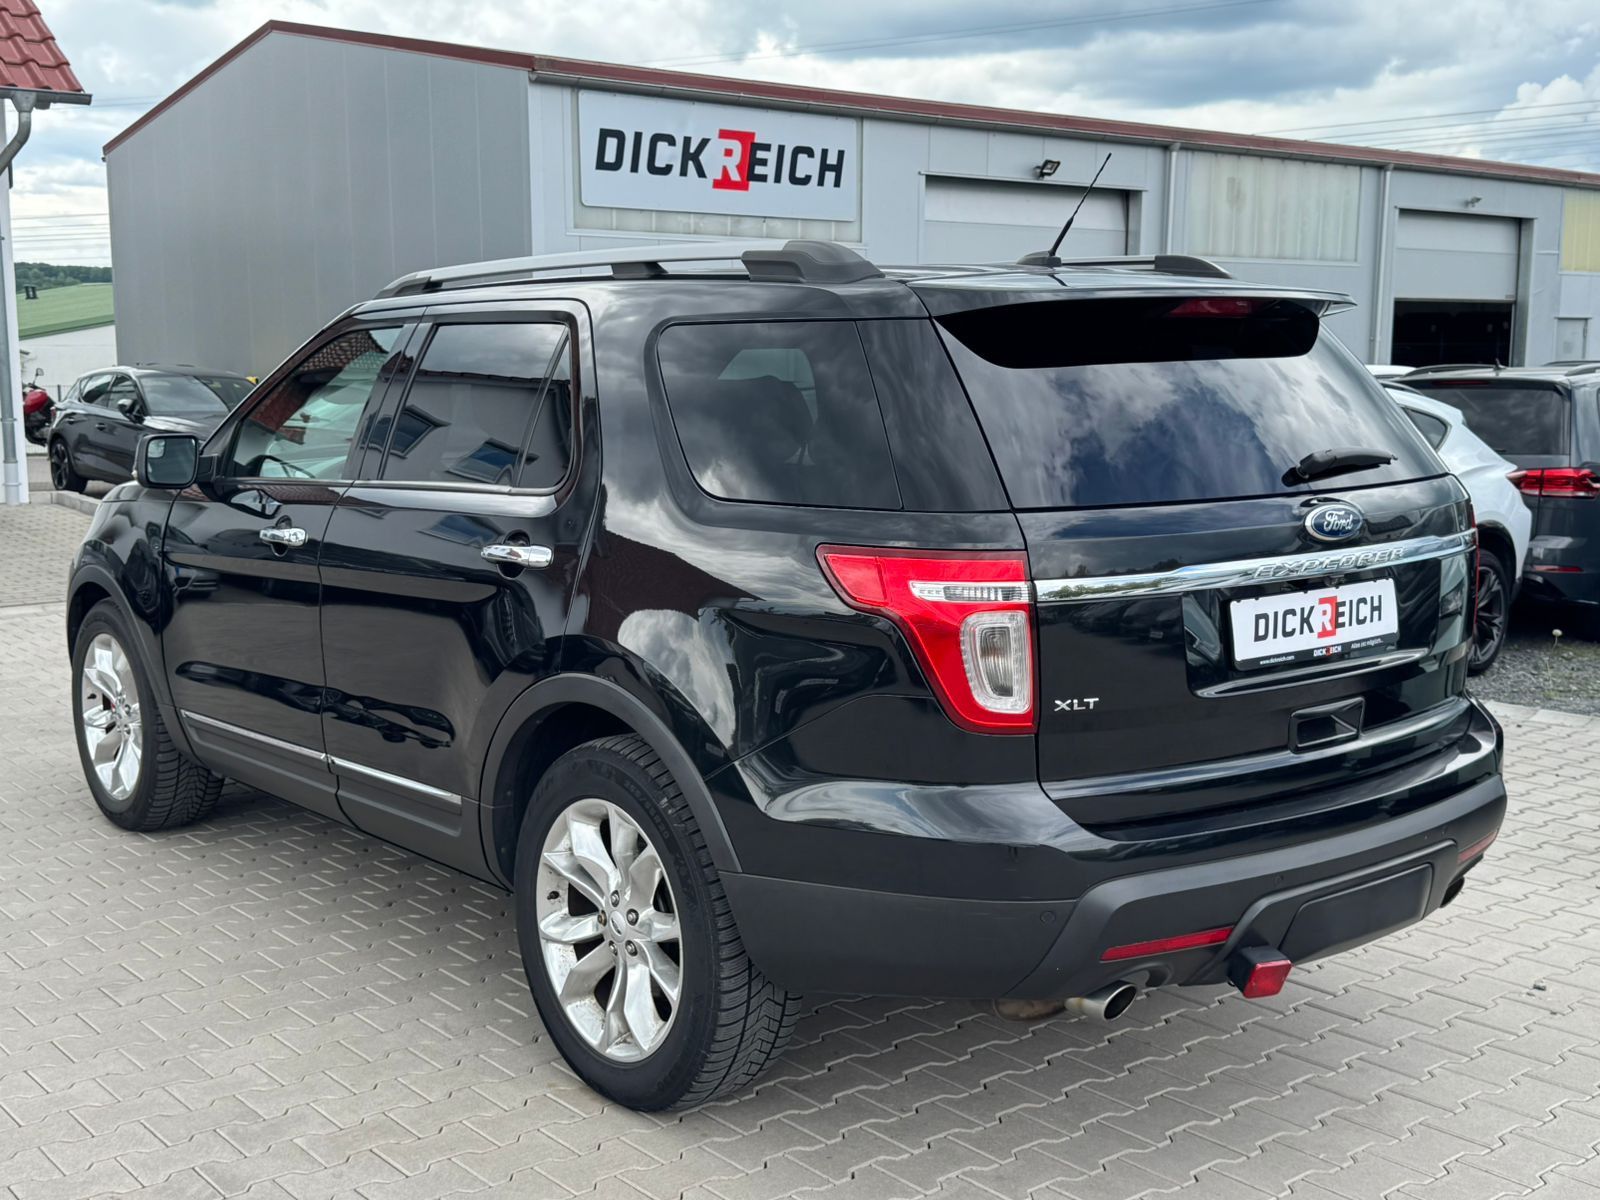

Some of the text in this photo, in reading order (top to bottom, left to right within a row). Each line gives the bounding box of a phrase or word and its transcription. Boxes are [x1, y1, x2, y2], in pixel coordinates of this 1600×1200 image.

[595, 128, 845, 191] DICKREICH
[1323, 510, 1354, 532] Ford
[1254, 546, 1404, 579] EXPLORER
[1253, 595, 1382, 642] DICKREICH
[1054, 697, 1099, 712] XLT
